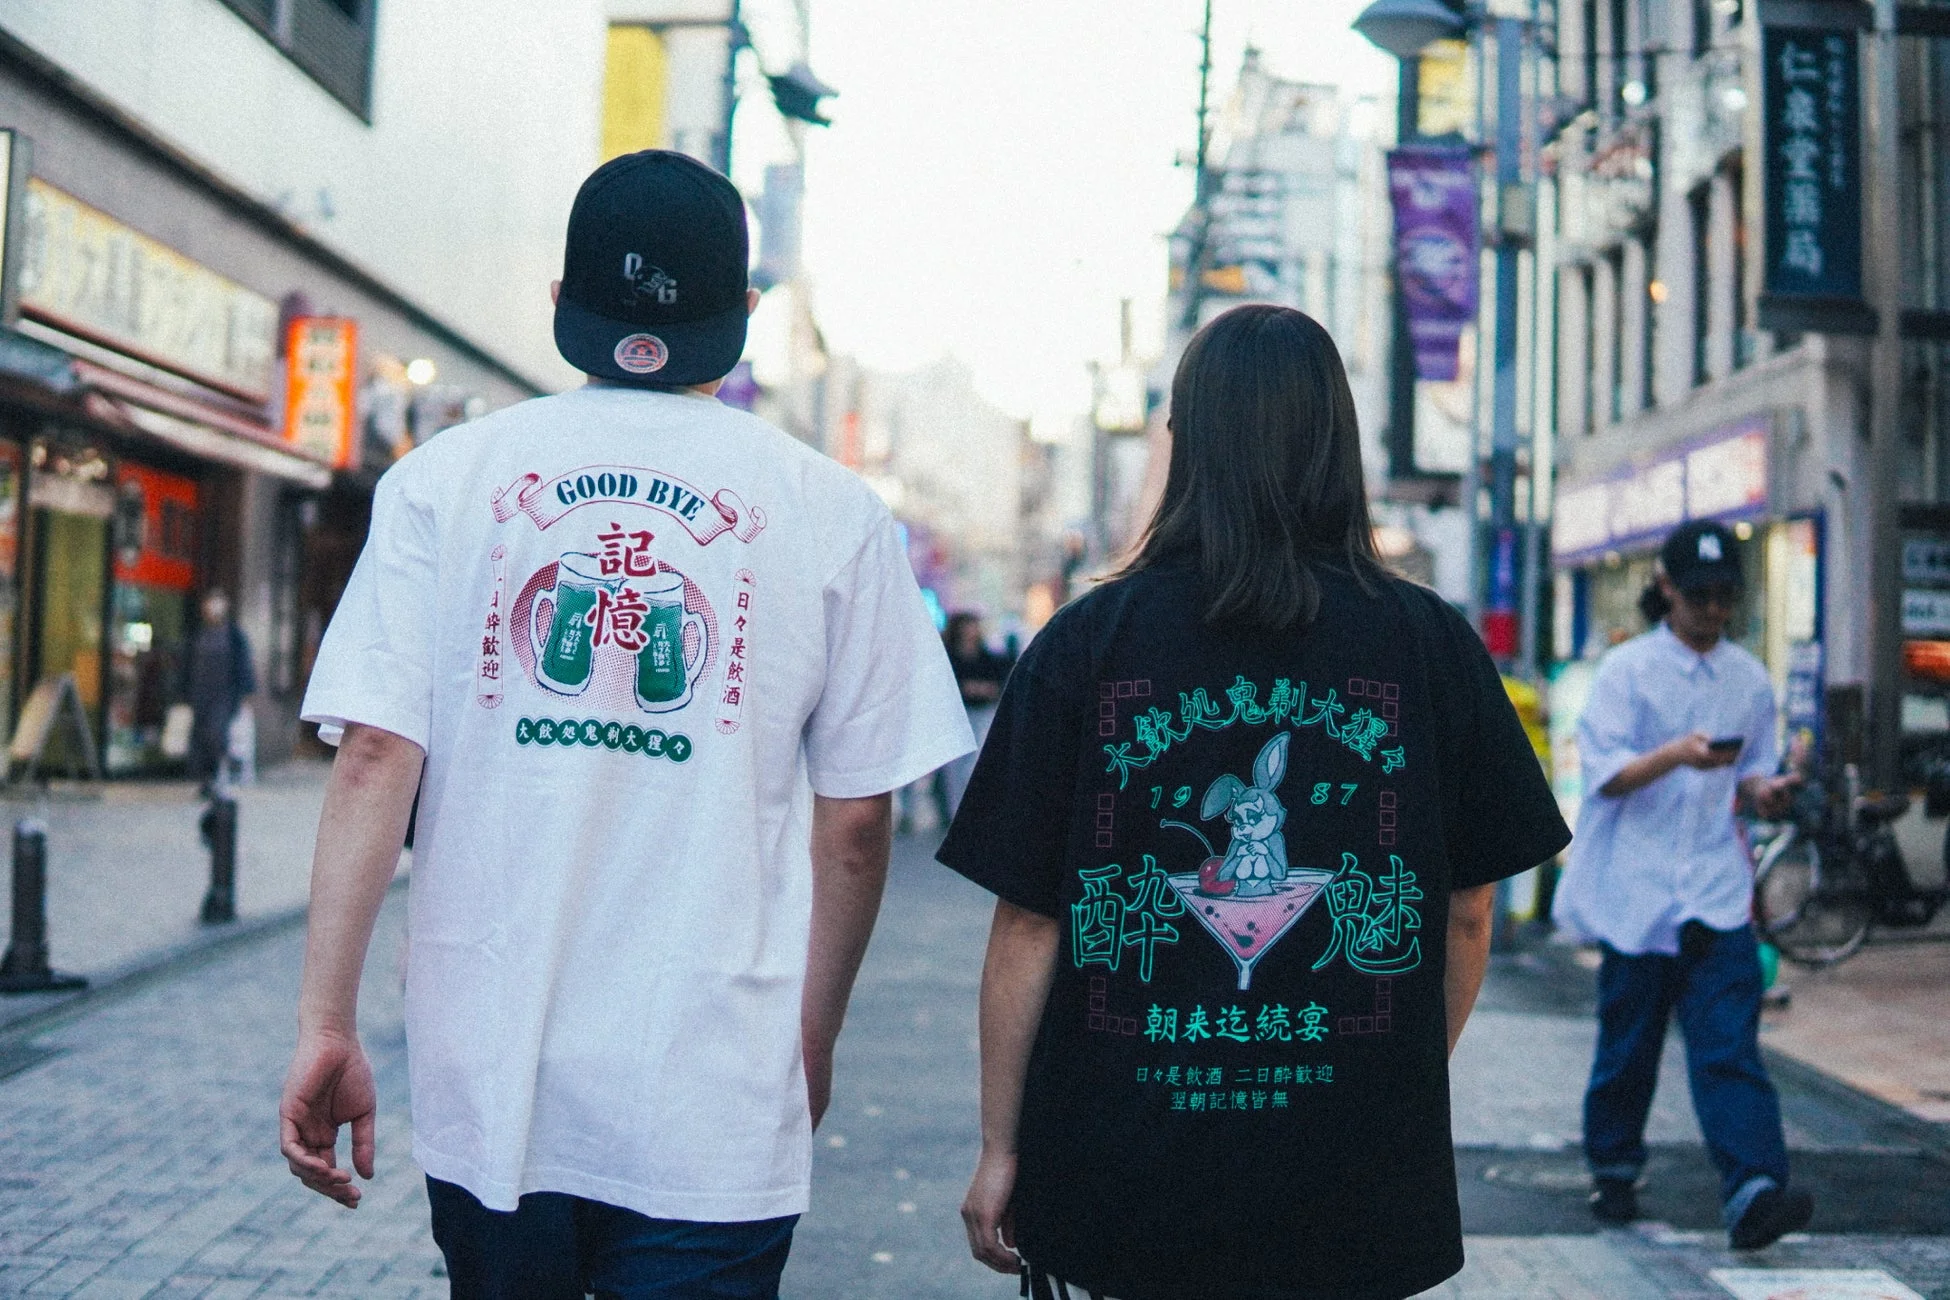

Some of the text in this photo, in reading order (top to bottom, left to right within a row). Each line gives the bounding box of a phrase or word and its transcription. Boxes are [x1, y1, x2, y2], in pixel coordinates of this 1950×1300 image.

[556, 472, 706, 522] GOOD BYE
[587, 521, 657, 652] 記憶
[723, 591, 750, 706] 日々是飲酒
[1150, 782, 1358, 809] 19 87
[1143, 1002, 1330, 1043] 朝来迄続宴
[1135, 1065, 1223, 1086] 日々是飲酒
[1170, 1089, 1289, 1112] 翌朝記憶皆無
